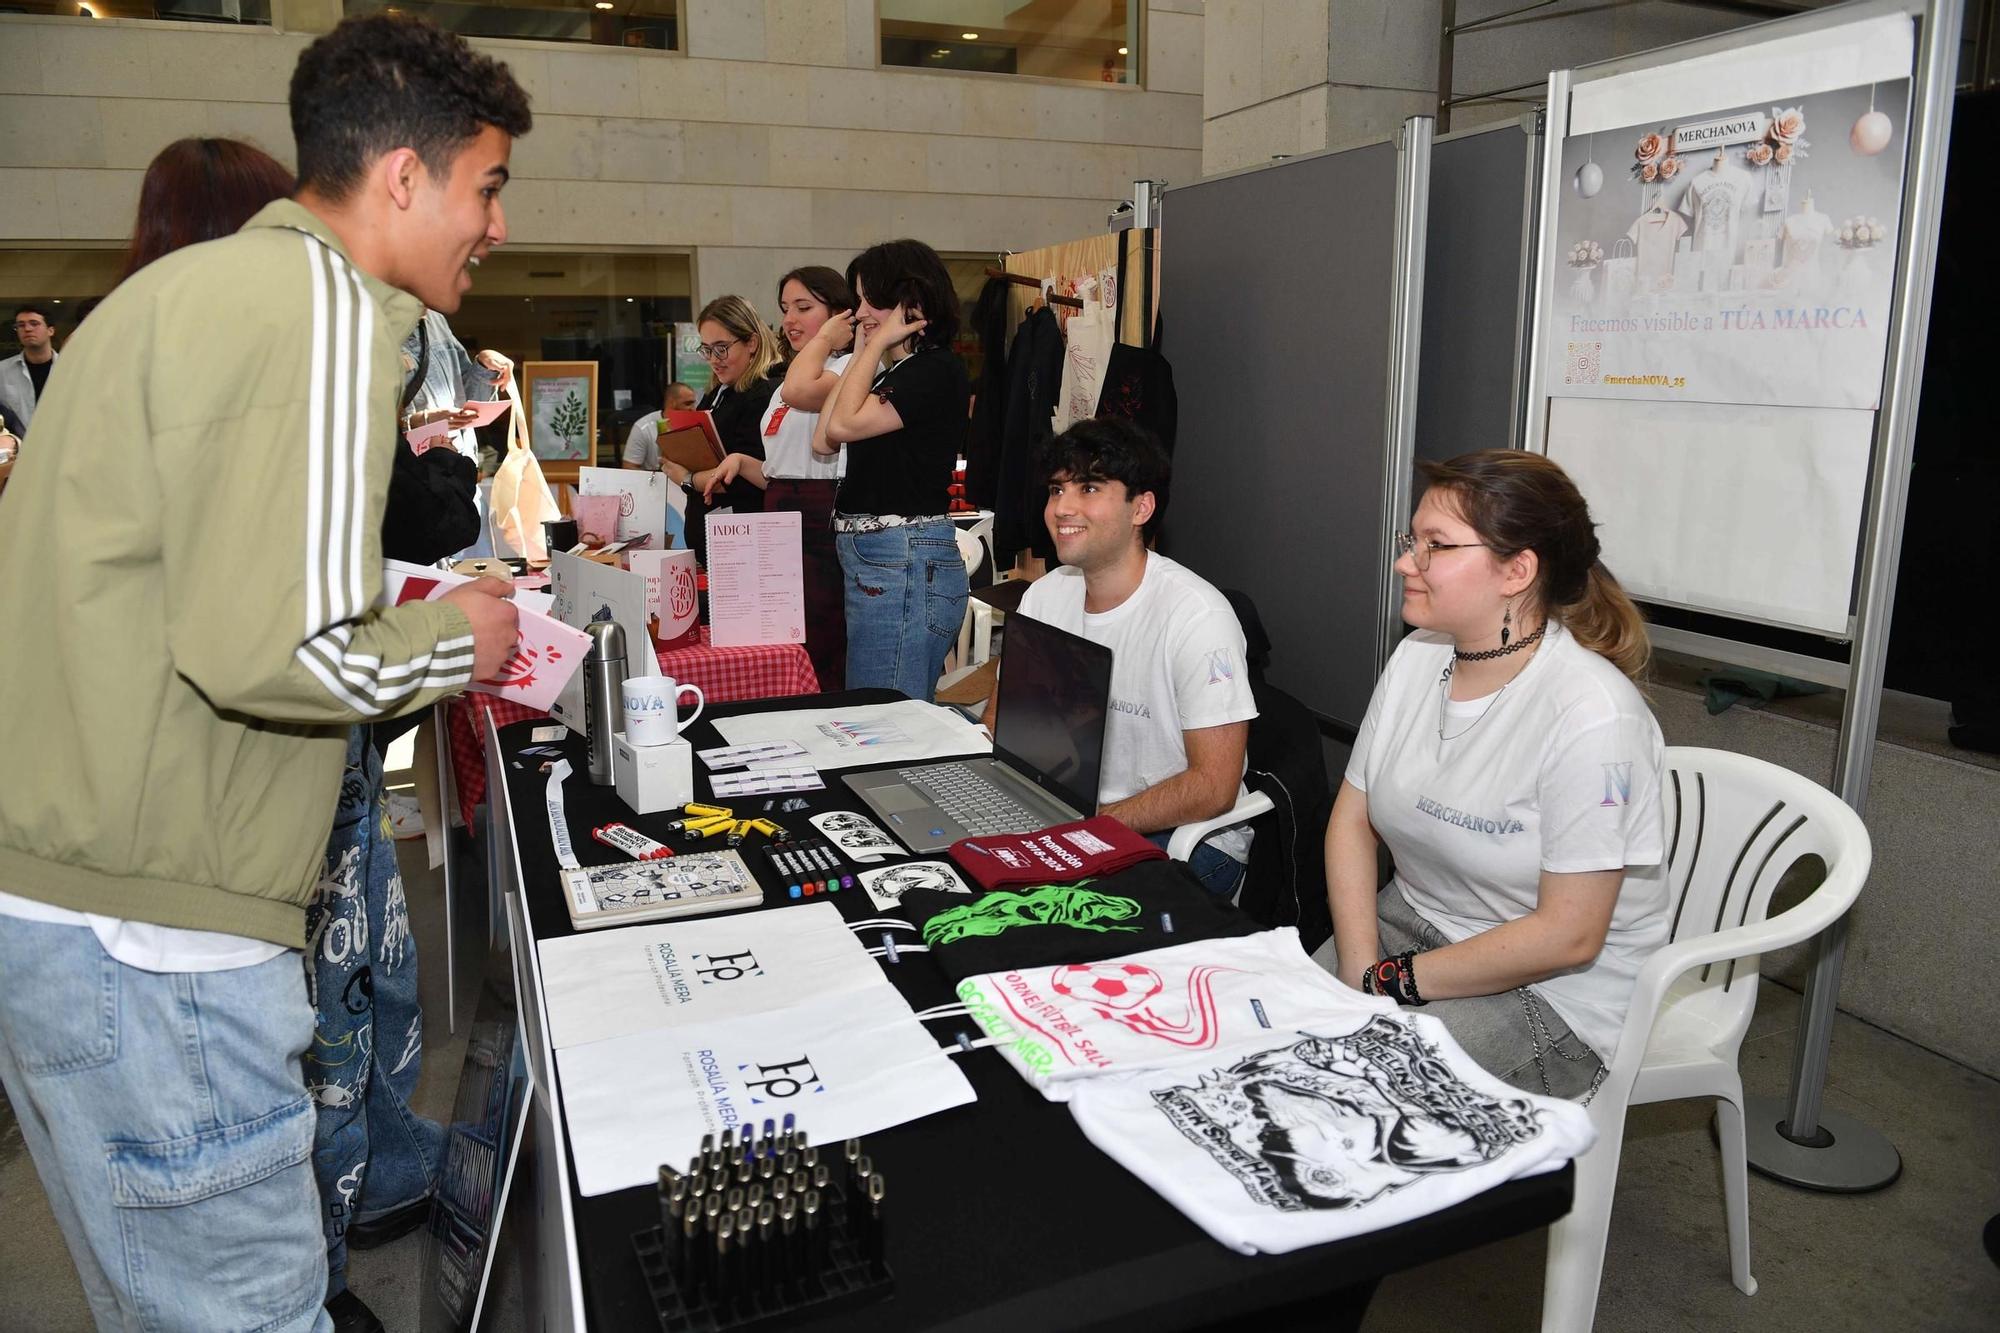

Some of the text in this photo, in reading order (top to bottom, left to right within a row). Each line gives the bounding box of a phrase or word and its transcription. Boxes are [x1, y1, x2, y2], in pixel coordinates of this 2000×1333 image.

[1678, 120, 1756, 143] MERCHANOVA
[1570, 304, 1868, 333] Facemos visible a TÚA MARCA
[1603, 374, 1685, 388] @merchaNOVA_25
[1204, 647, 1235, 685] N
[1599, 761, 1634, 807] N
[1415, 795, 1524, 835] MERCHANOVA
[1038, 835, 1084, 869] Promoción
[657, 942, 693, 1004] ROSALÍA MERA
[697, 1049, 741, 1131] ROSALÍA MERA
